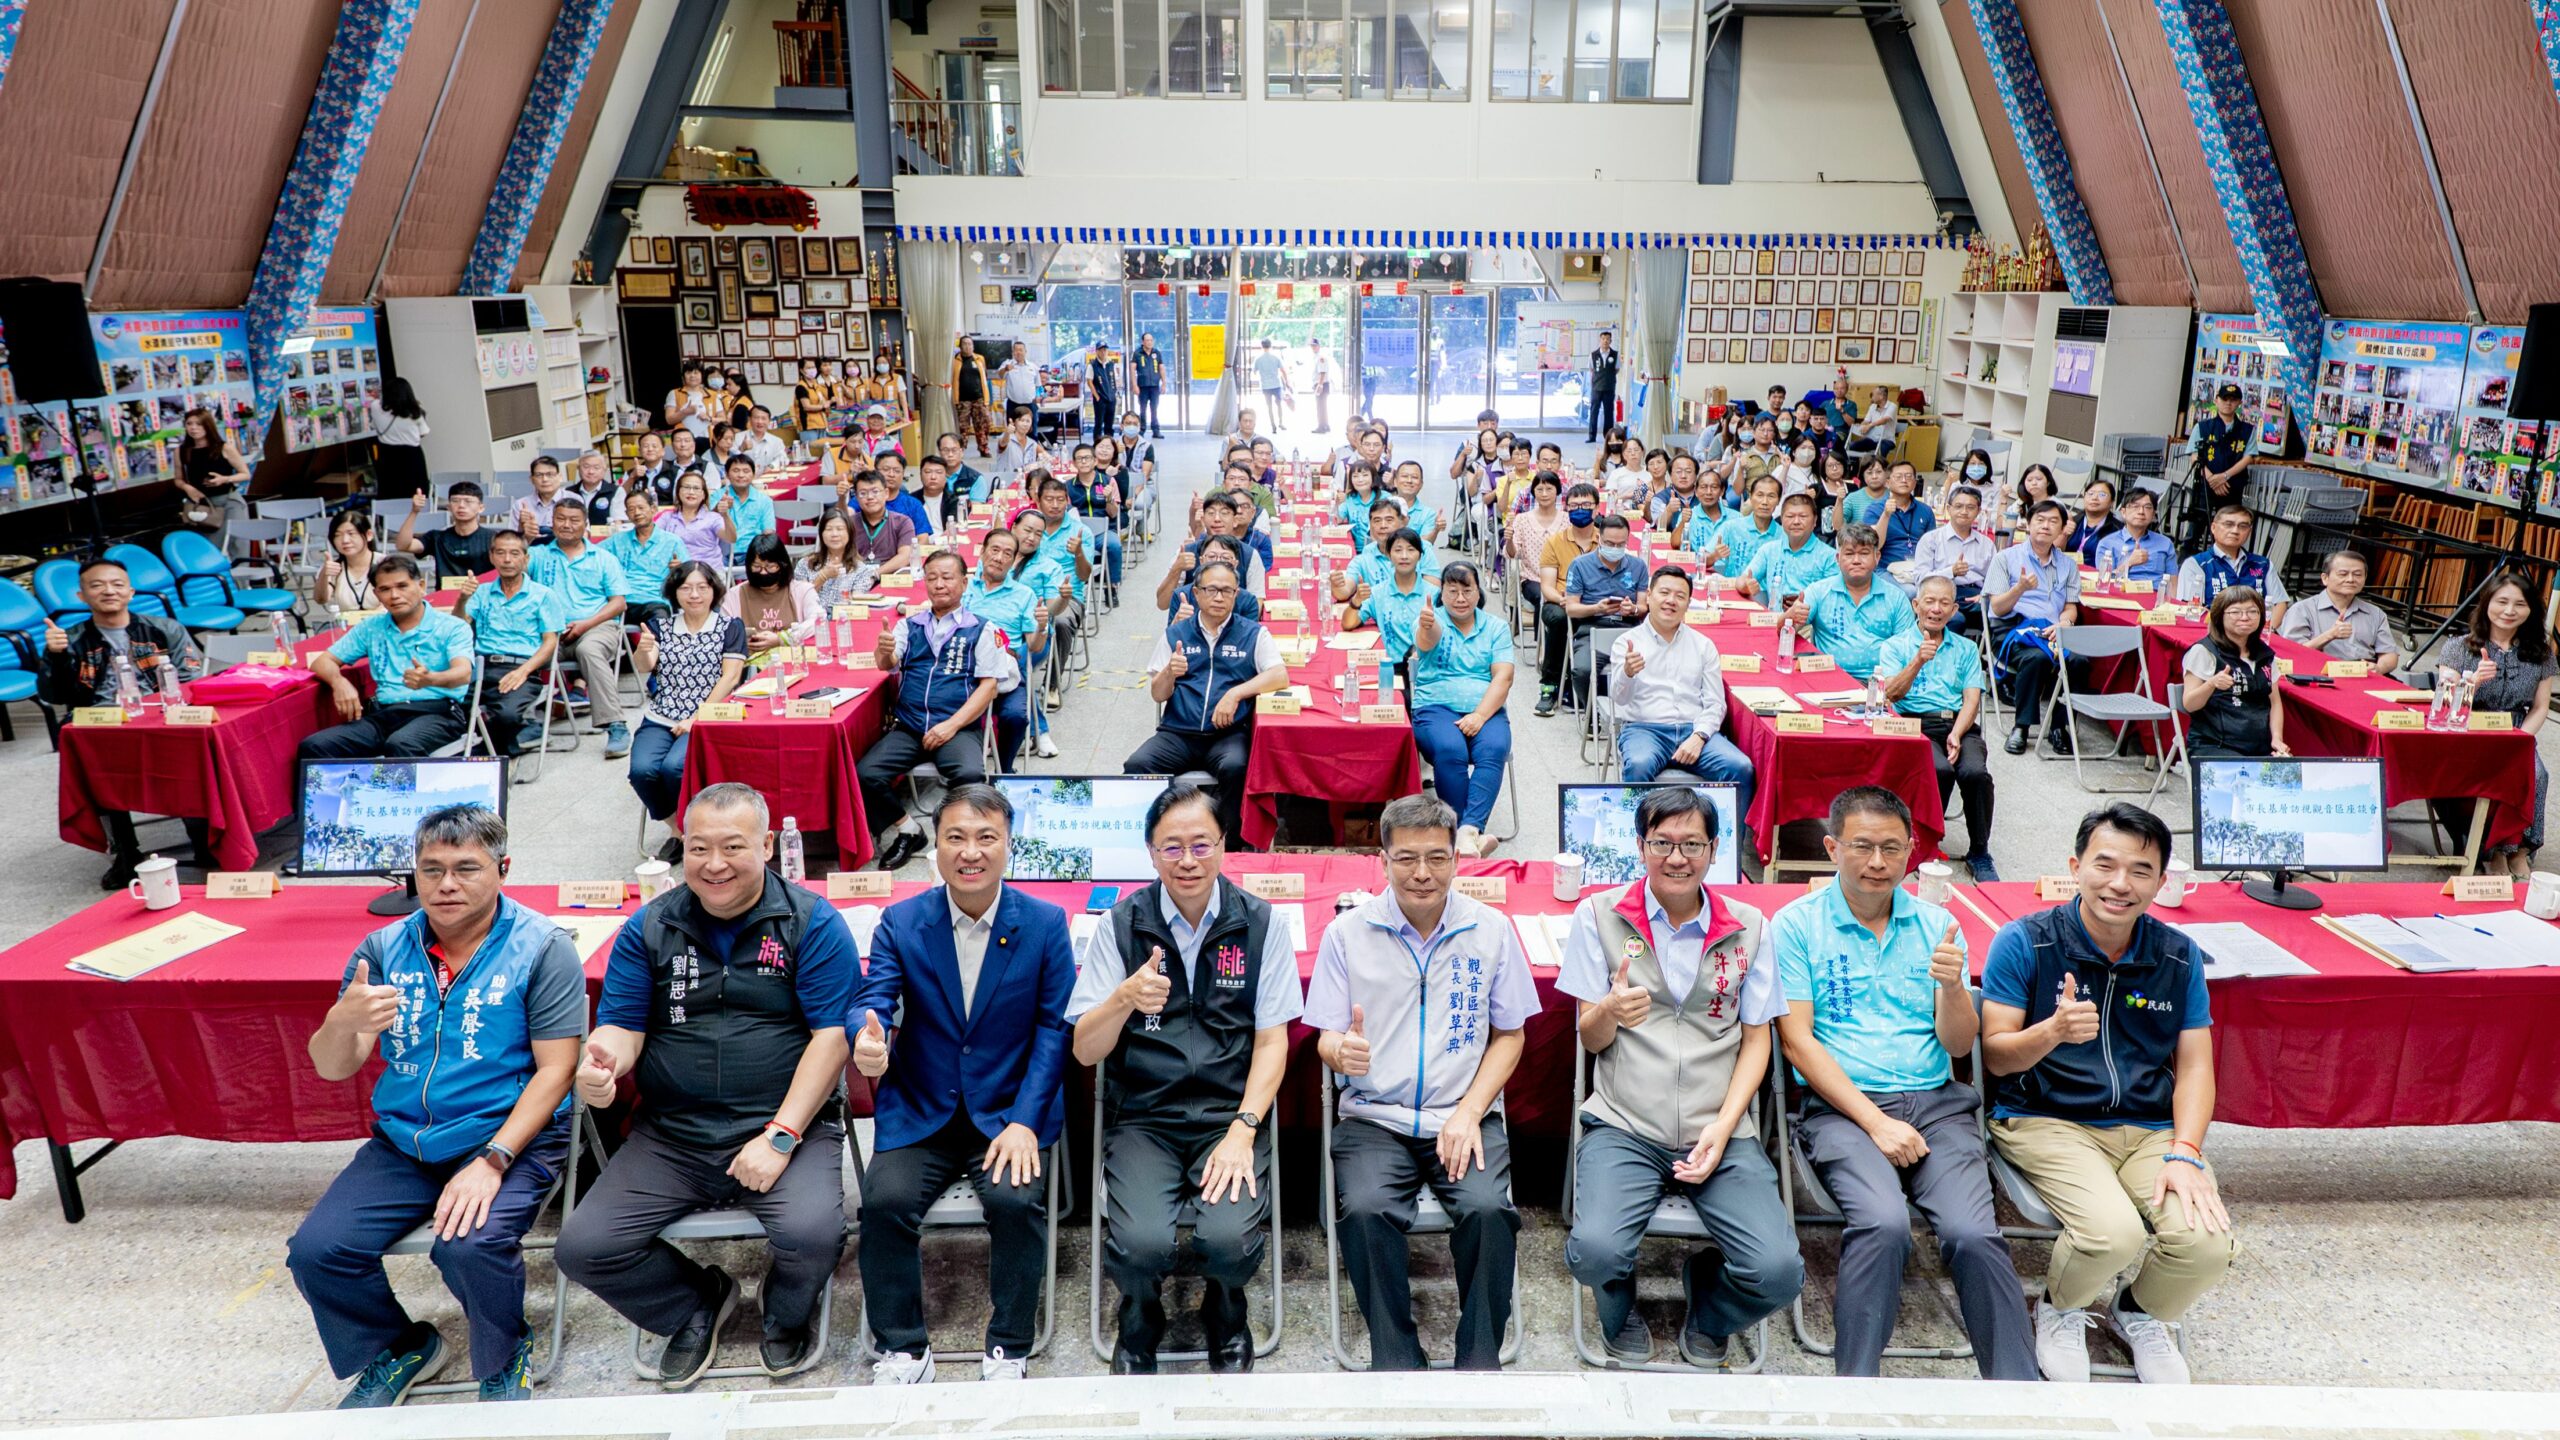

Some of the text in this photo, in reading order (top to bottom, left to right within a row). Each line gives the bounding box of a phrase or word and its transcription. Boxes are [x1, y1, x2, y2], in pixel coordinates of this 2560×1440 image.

[2365, 343, 2428, 358] 關懷社區 執行成果
[758, 618, 783, 630] Own
[763, 608, 781, 620] My
[2245, 803, 2378, 815] 市長基層訪視觀音區座談會
[487, 974, 507, 1006] 助理
[1707, 951, 1730, 1018] 許更生
[1446, 957, 1464, 1055] 區長 劉草典
[1463, 957, 1483, 1047] 觀音區公所
[2147, 1000, 2173, 1012] 民政局
[461, 988, 485, 1060] 吳聲良
